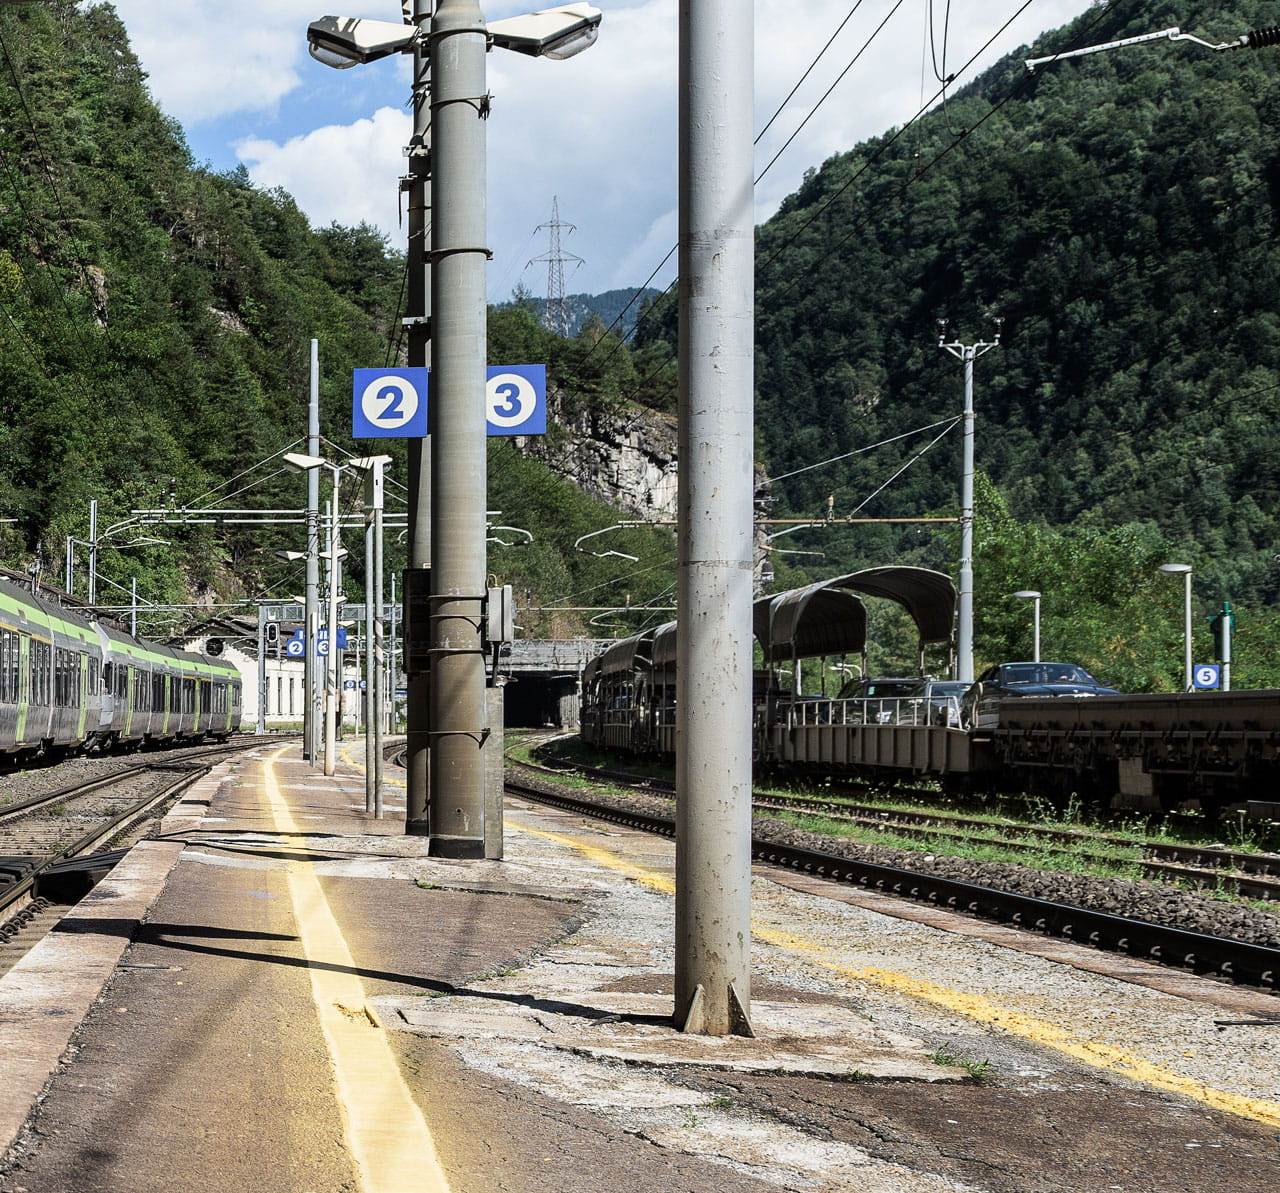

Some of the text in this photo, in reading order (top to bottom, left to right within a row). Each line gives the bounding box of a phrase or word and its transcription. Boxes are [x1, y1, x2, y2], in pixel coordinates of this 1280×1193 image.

[376, 385, 404, 420] 2
[493, 382, 522, 418] 3
[292, 643, 300, 653] 2
[1202, 670, 1212, 682] 5
